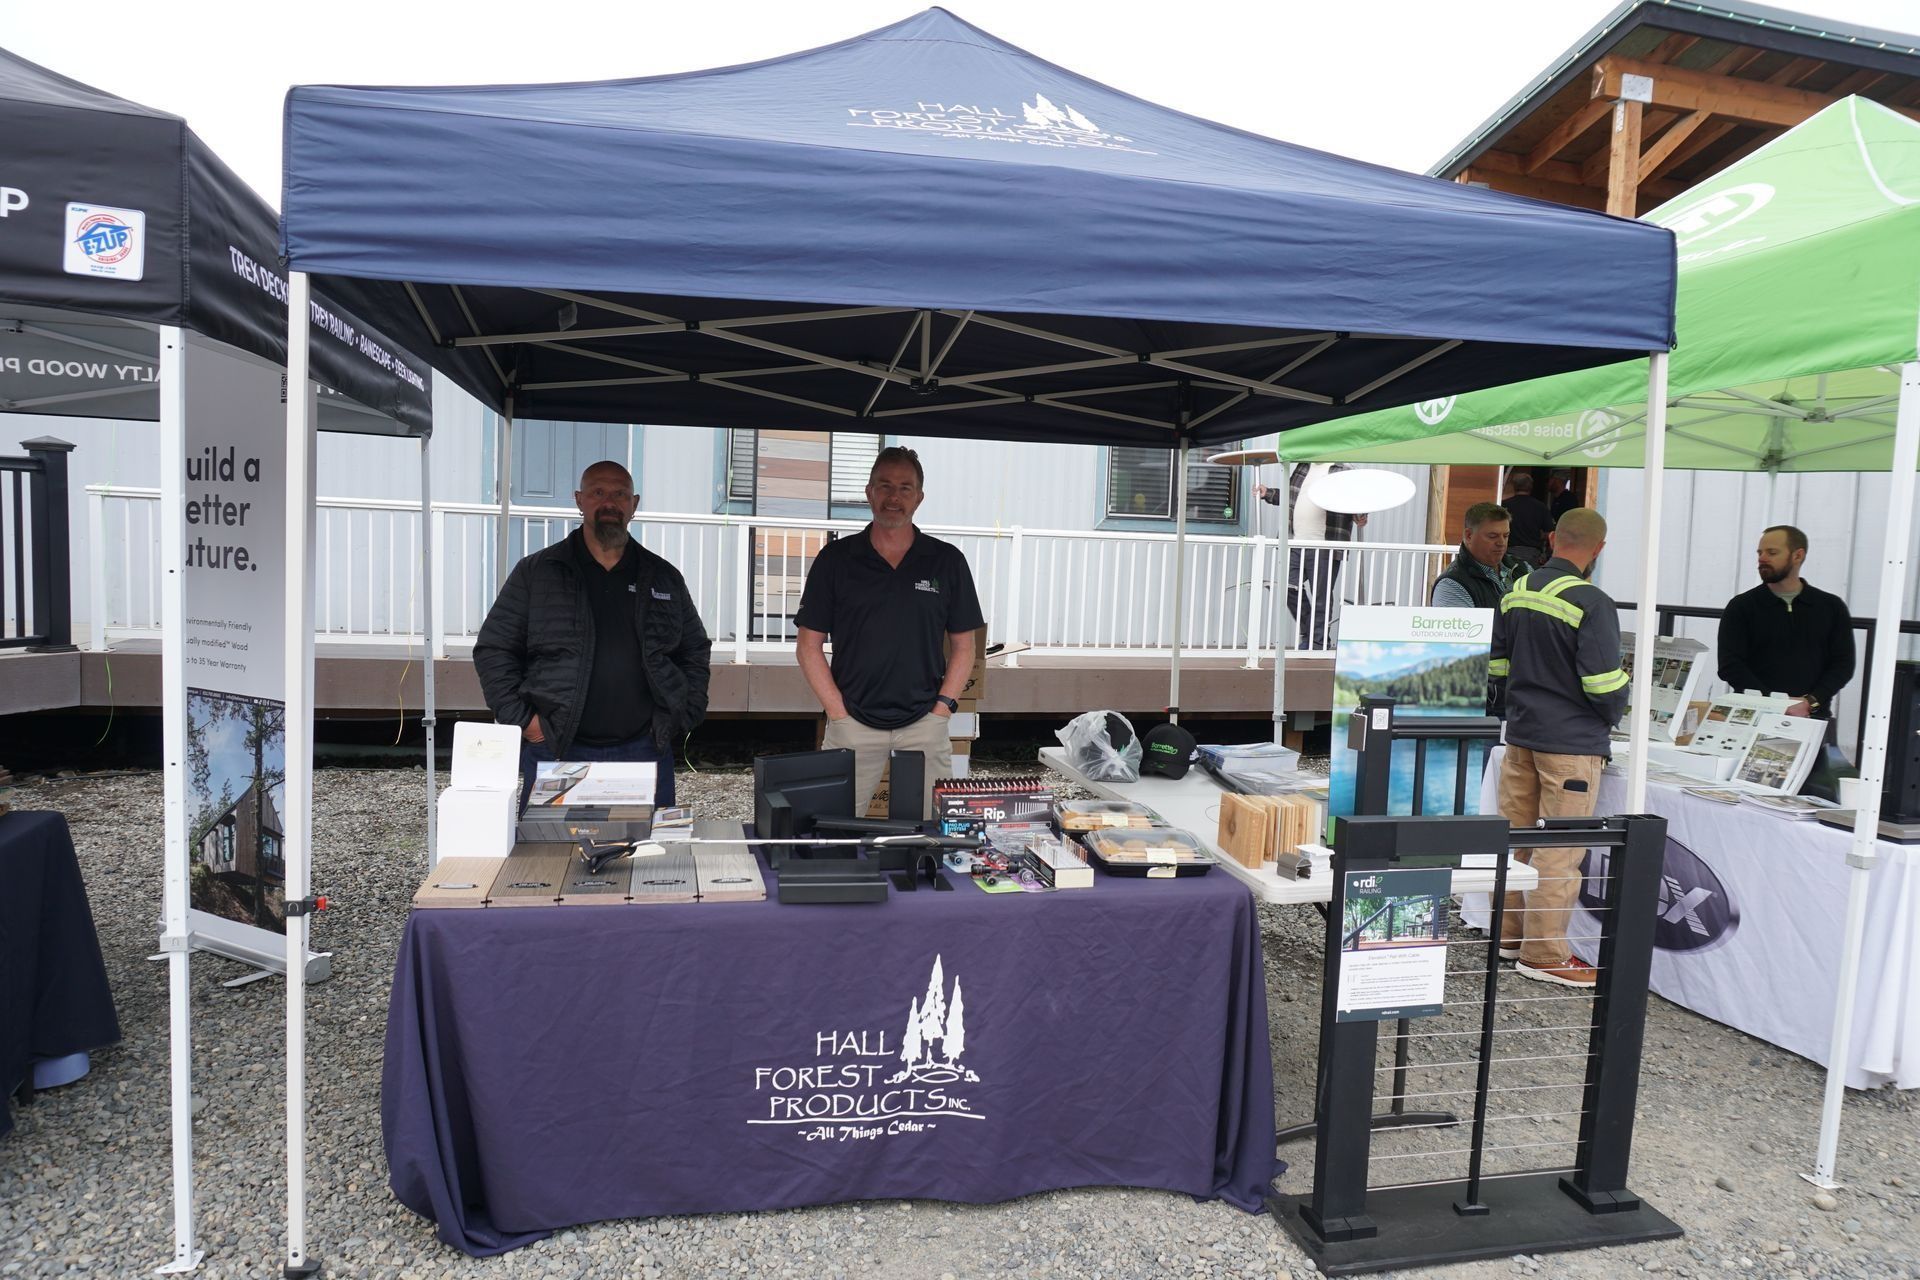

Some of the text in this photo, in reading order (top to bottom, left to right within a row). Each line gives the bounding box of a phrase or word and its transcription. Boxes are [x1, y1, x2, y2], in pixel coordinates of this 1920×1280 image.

[848, 108, 1006, 125] FOREST
[917, 102, 1017, 118] HALL
[872, 118, 1103, 145] PRODUCTS
[229, 245, 261, 288] TREX
[310, 299, 328, 331] TREX
[329, 312, 355, 346] RAILING
[359, 334, 391, 371] RAINESCAPE
[186, 446, 260, 482] uild a
[186, 493, 251, 526] etter
[186, 537, 257, 572] ture.
[228, 620, 252, 632] Friendly
[1411, 615, 1471, 630] Barrette
[1411, 630, 1444, 638] OUTDOOR
[231, 641, 249, 651] Wood
[206, 658, 219, 667] Year
[220, 660, 247, 672] Warranty
[1359, 876, 1376, 888] rdi
[816, 1030, 895, 1056] HALL
[755, 1064, 883, 1091] FOREST
[769, 1088, 947, 1119] PRODUCTS
[839, 1125, 883, 1141] Things
[887, 1120, 925, 1135] Cedar
